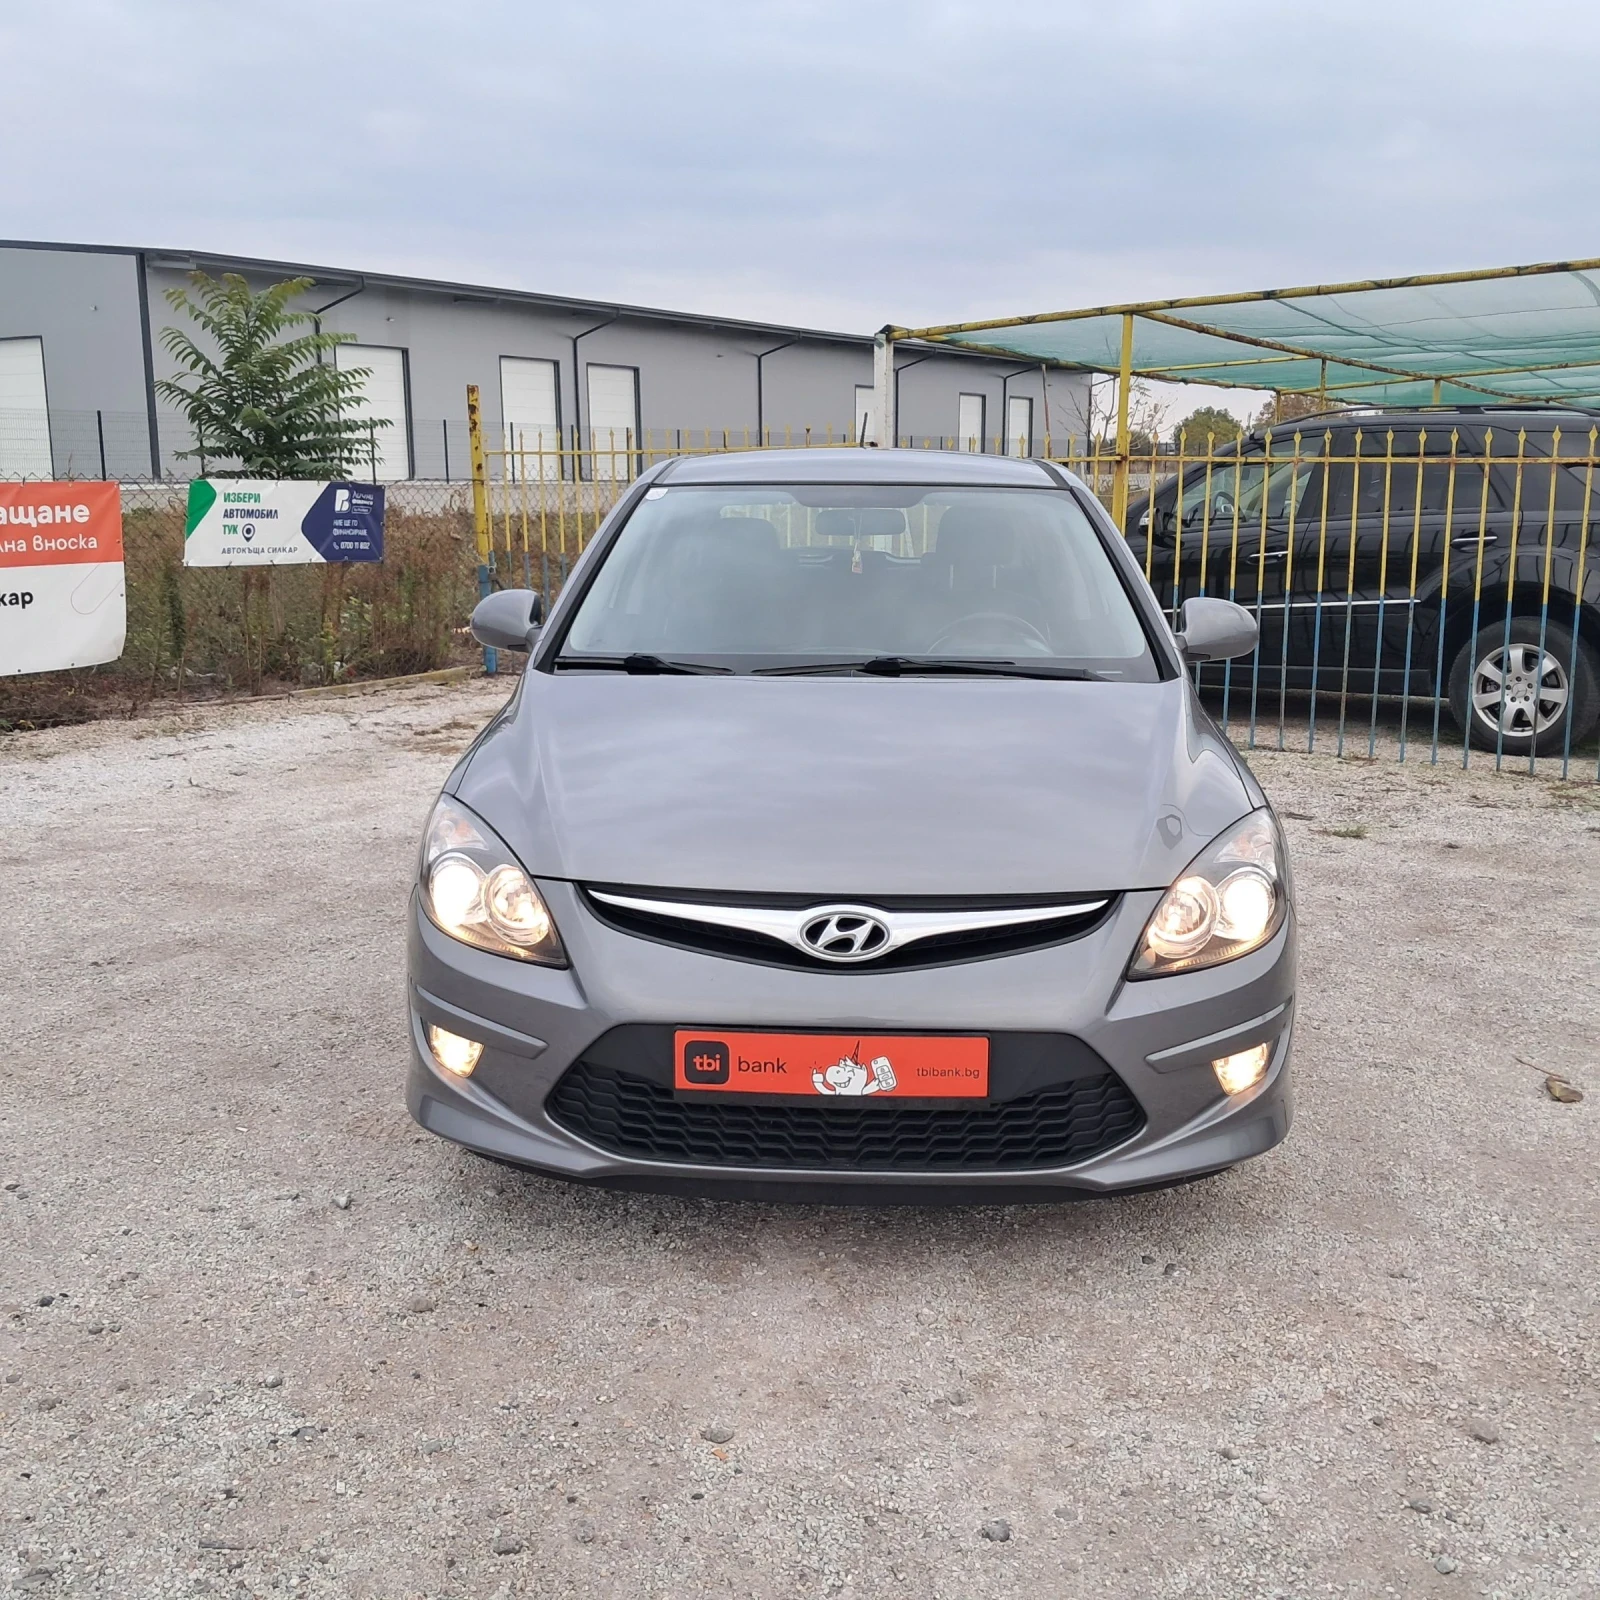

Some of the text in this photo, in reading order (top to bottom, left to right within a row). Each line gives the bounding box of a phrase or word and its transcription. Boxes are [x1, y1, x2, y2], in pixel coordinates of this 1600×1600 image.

[223, 492, 261, 503] ИЗБЕРИ
[223, 508, 278, 519] АВТОМОБИЛ
[222, 524, 238, 535] ТУК
[33, 533, 98, 551] вноска
[340, 541, 354, 550] 0700
[221, 546, 298, 556] АВТОКЪЩА СИЛКАР
[693, 1053, 788, 1074] tbi bank
[916, 1066, 980, 1079] tbibank.bg
